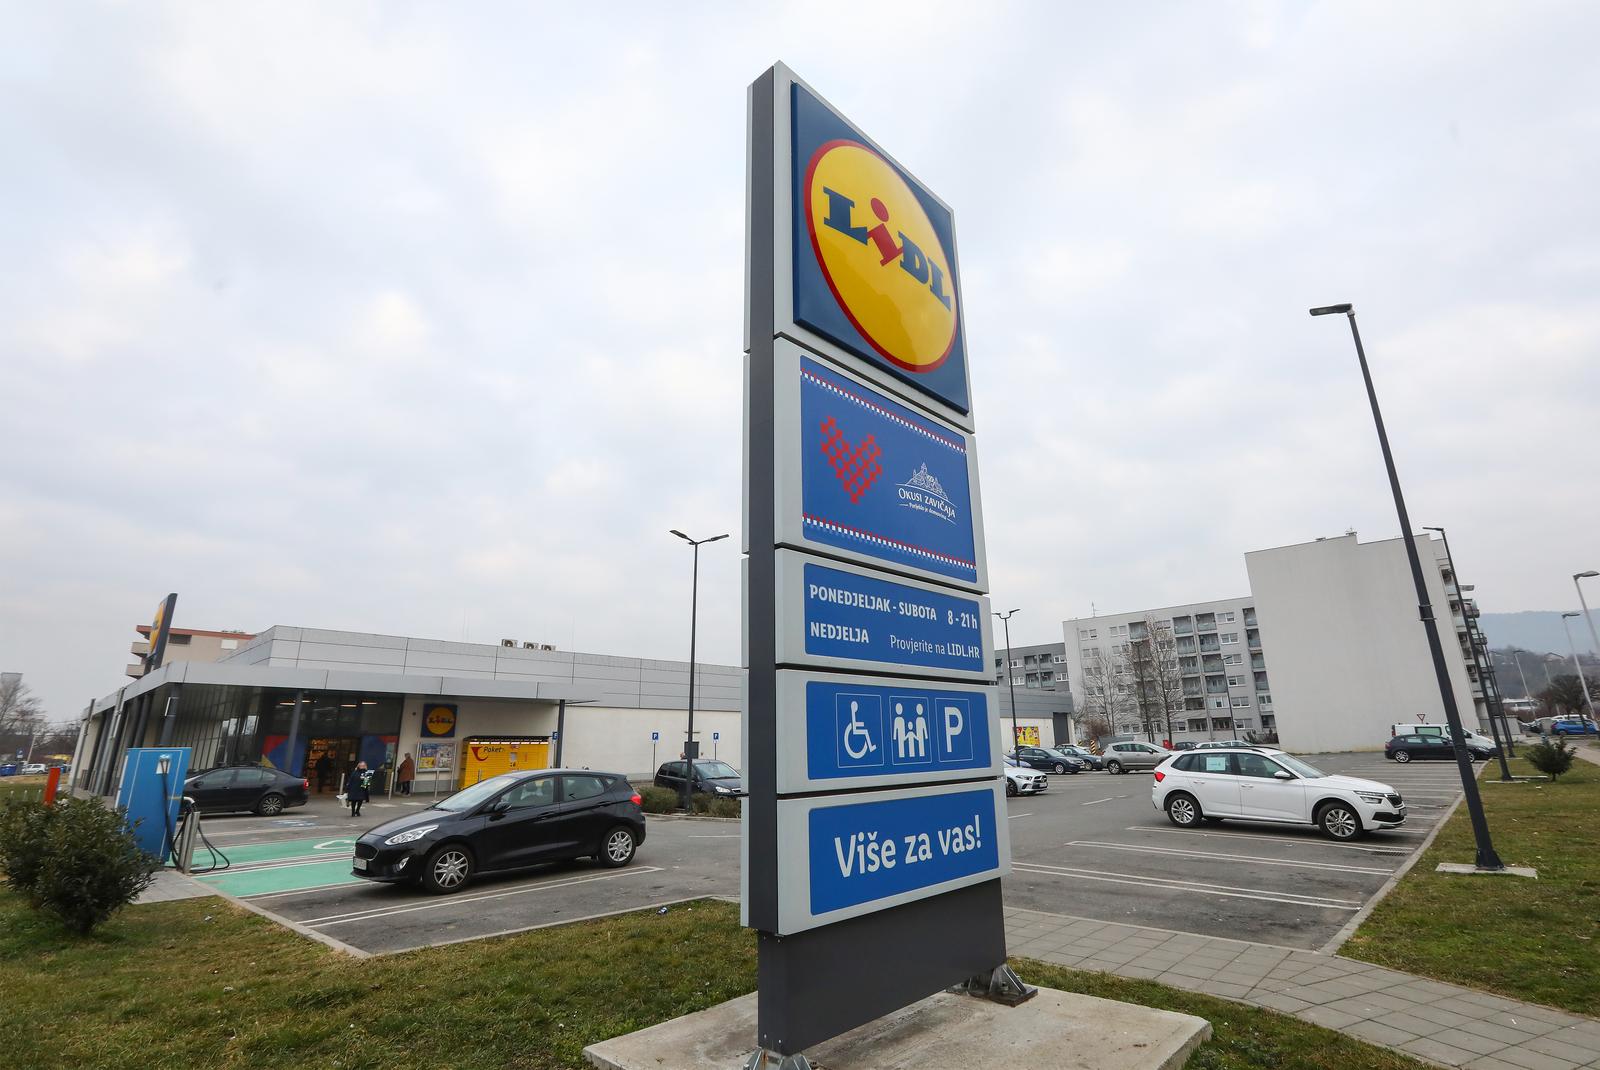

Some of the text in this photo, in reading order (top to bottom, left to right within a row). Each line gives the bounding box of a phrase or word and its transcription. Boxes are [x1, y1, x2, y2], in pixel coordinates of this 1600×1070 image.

[898, 487, 956, 519] OKUSI ZAVIČAJA
[809, 584, 891, 613] PONEDJELJAK
[898, 601, 937, 621] SUBOTA
[947, 609, 954, 626] 8
[810, 621, 870, 644] NEDJELJA
[890, 634, 980, 659] Provjerite na LIDL.HR
[944, 706, 964, 753] P
[834, 814, 982, 878] Više za vas!
